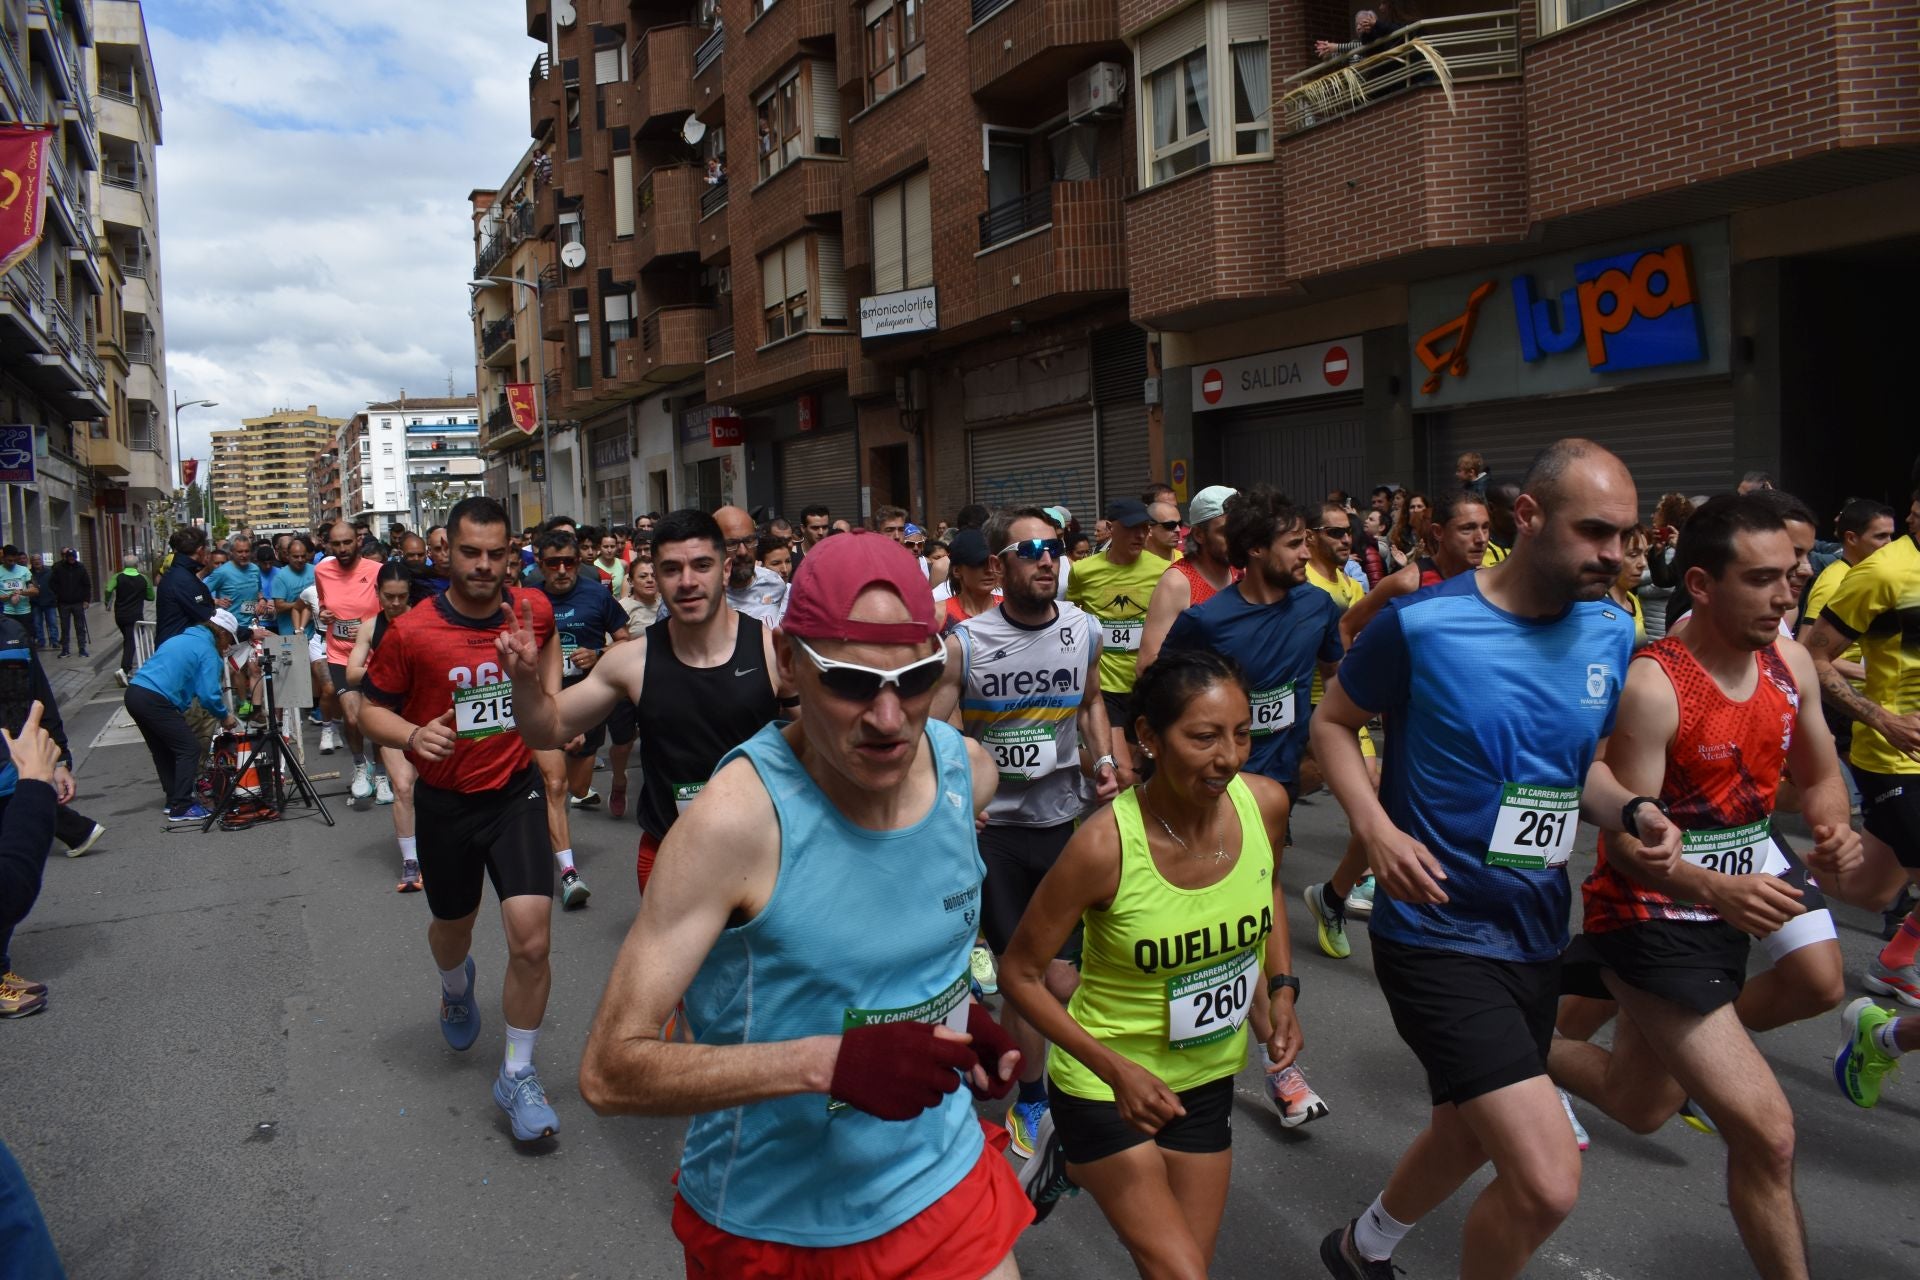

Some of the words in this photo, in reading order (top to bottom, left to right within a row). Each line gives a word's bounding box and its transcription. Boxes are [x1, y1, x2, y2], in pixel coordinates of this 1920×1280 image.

[27, 141, 38, 170] PASO
[24, 176, 36, 235] VIVIENTE
[862, 296, 933, 318] @monicolorlife
[1511, 243, 1694, 368] lupa
[1241, 362, 1302, 391] SALIDA
[715, 426, 739, 438] Dia
[1112, 629, 1130, 643] 84
[448, 661, 510, 689] 36
[981, 667, 1080, 697] aresol
[472, 686, 496, 695] CARRERA
[471, 696, 513, 724] 215
[1004, 695, 1064, 711] renovables
[1020, 728, 1045, 736] POPULAR
[995, 744, 1040, 767] 302
[1506, 796, 1538, 807] CALAHORRA
[1539, 800, 1557, 808] CIUDAD
[1517, 787, 1527, 796] XV
[1528, 789, 1559, 799] CARRERA
[1514, 811, 1567, 847] 261
[1703, 832, 1735, 842] CARRERA
[1736, 825, 1762, 837] POPULAR
[1682, 843, 1716, 851] CALAHORRA
[1717, 840, 1735, 849] CIUDAD
[1741, 837, 1748, 845] LA
[1748, 831, 1767, 843] VERDURA
[1135, 905, 1272, 974] QUELLCA
[1173, 980, 1208, 997] CALAHORRA
[1208, 974, 1228, 986] CIUDAD
[1234, 966, 1241, 975] LA
[1181, 975, 1191, 984] XV
[1193, 964, 1226, 981] CARRERA
[866, 1015, 881, 1025] XV
[884, 1003, 931, 1023] CARRERA
[930, 1010, 940, 1020] DE
[940, 1005, 948, 1016] LA
[1194, 984, 1247, 1038] 260
